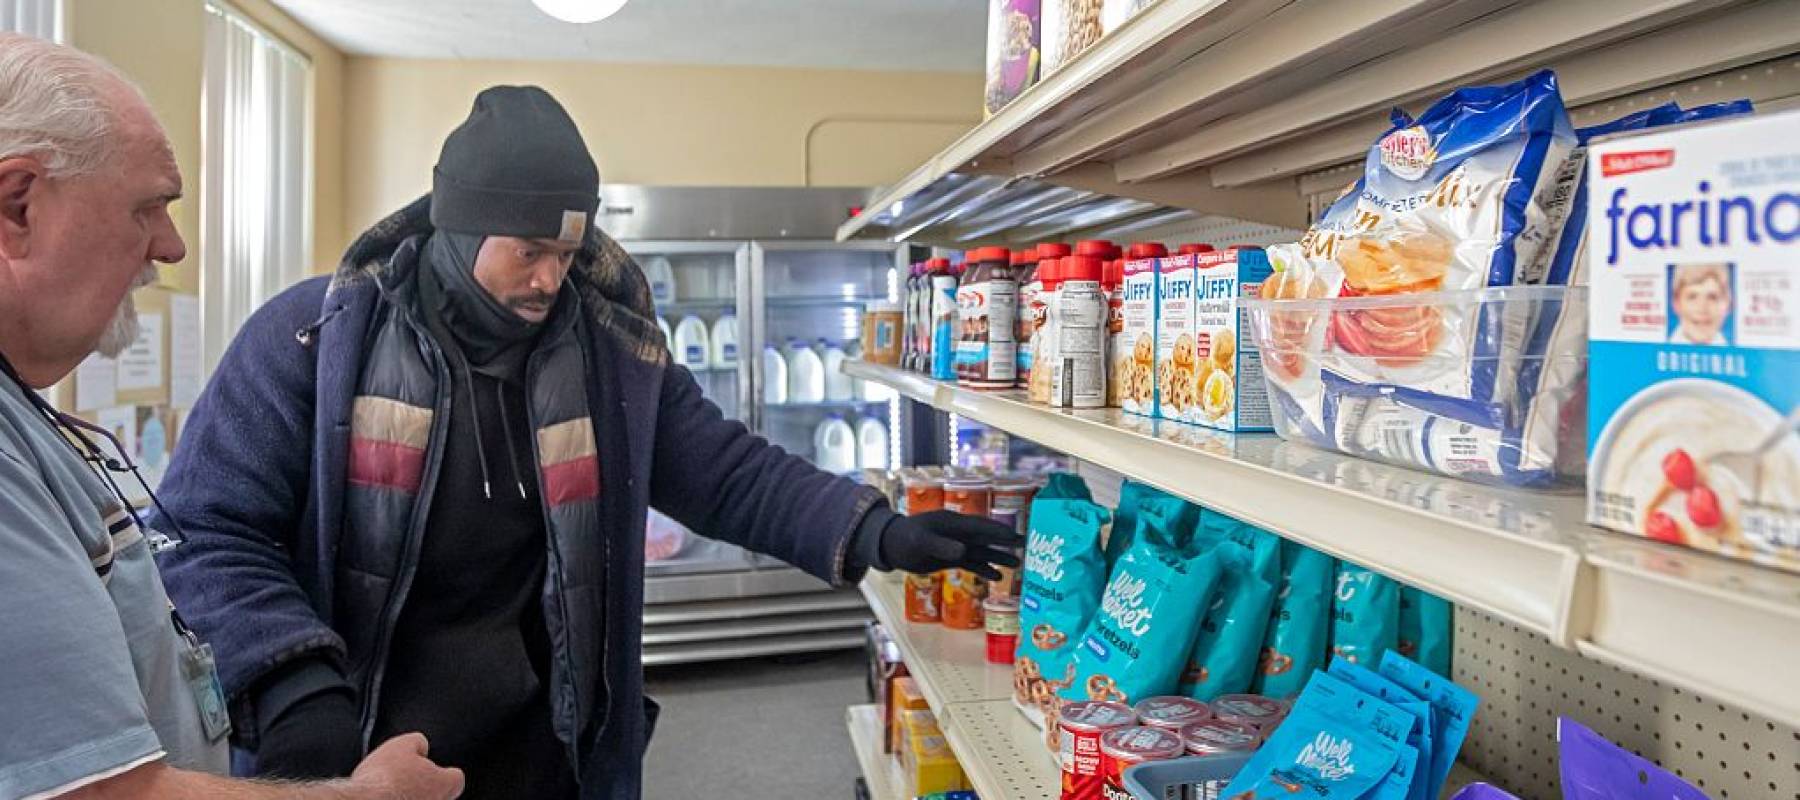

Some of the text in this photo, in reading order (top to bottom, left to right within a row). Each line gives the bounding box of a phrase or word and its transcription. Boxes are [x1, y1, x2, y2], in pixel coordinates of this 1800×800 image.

[1124, 278, 1153, 301] JIFFY
[1160, 276, 1191, 300] JIFFY
[1197, 275, 1234, 300] JIFFY
[1656, 351, 1747, 378] ORIGINAL
[1112, 569, 1146, 608] Well
[1101, 582, 1152, 637] Market
[1314, 730, 1353, 766] Well
